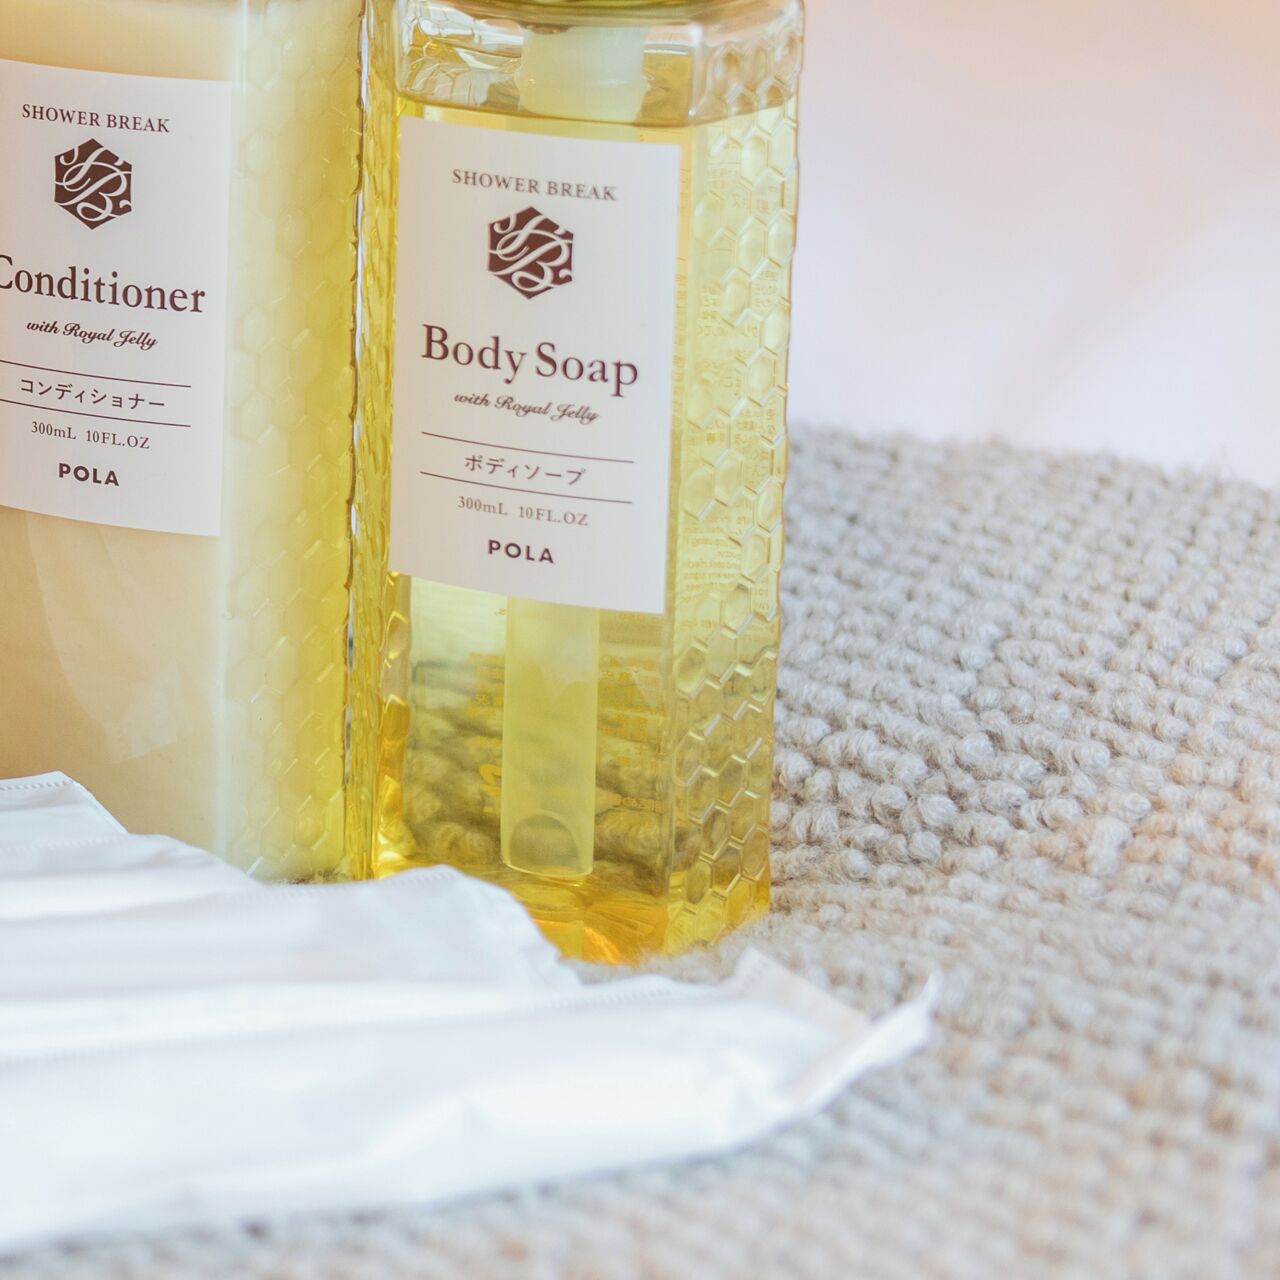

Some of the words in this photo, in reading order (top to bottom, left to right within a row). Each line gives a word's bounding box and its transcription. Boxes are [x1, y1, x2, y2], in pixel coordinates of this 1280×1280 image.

[22, 103, 101, 127] SHOWER
[106, 113, 170, 133] BREAK
[452, 168, 540, 194] SHOWER
[546, 180, 616, 201] BREAK
[26, 320, 59, 335] with
[62, 322, 113, 344] Royal
[112, 328, 157, 351] Jelly
[421, 323, 527, 385] Body
[535, 341, 638, 398] Soap
[19, 376, 166, 410] コンディショナー
[453, 393, 490, 407] with
[493, 396, 551, 418] Royal
[553, 403, 599, 425] Jelly
[31, 420, 77, 440] 300mL
[86, 429, 150, 450] 10FL.OZ
[58, 462, 120, 487] POLA
[463, 453, 587, 487] ボディソープ
[457, 495, 508, 516] 300mL
[519, 505, 588, 527] 10FL.OZ
[487, 539, 554, 564] POLA
